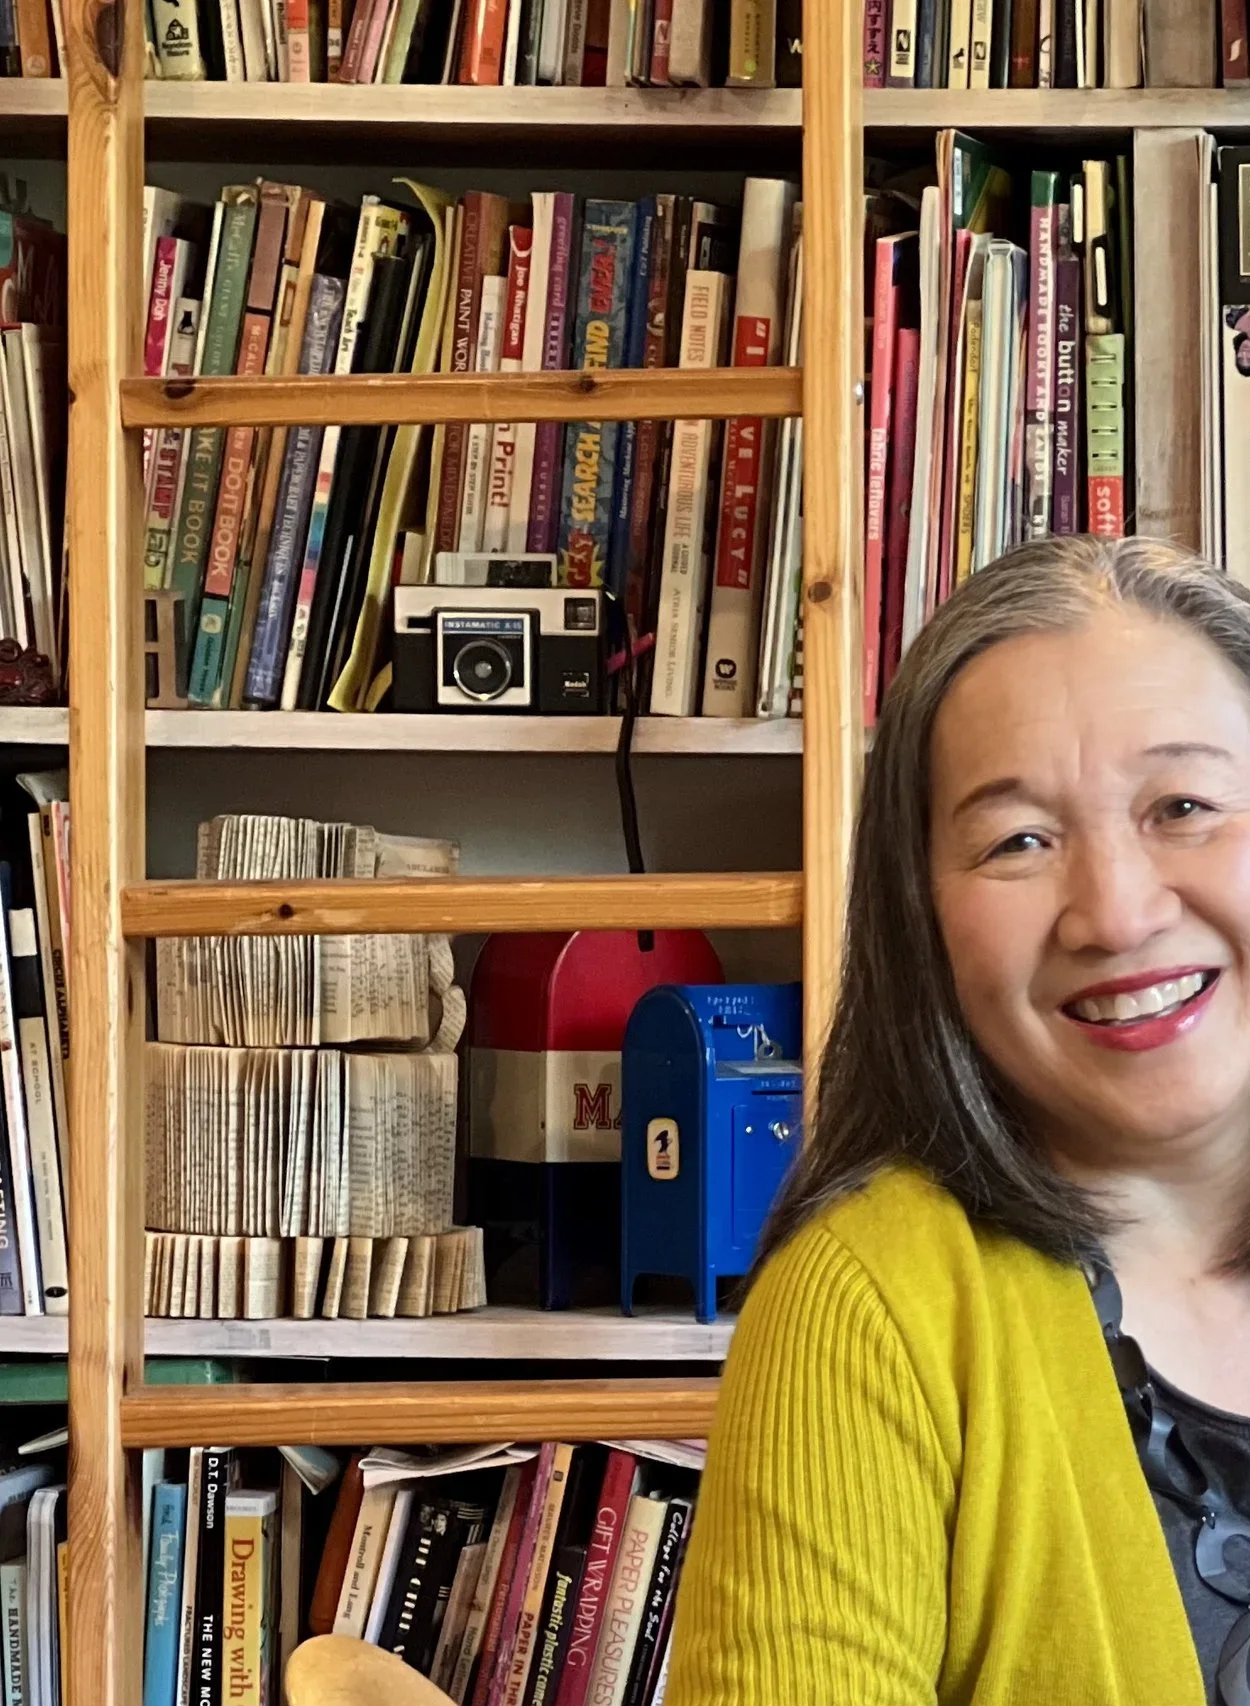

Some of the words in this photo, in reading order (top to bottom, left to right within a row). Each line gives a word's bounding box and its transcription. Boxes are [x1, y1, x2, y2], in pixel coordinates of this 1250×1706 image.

[550, 215, 569, 264] greeting
[158, 259, 173, 293] Jenny
[514, 263, 529, 286] Joe
[153, 296, 168, 321] Doh
[456, 287, 474, 332] PAINT
[509, 288, 527, 346] Rhatigan
[690, 284, 710, 320] FIELD
[1058, 303, 1076, 334] the
[686, 324, 708, 363] NOTES
[1055, 340, 1079, 414] button
[871, 427, 888, 471] fabric
[1054, 420, 1077, 477] maker
[489, 441, 516, 508] Print!
[570, 431, 603, 523] SEARCH
[675, 431, 701, 513] ADVENTUROUS
[672, 514, 692, 539] LIFE
[866, 471, 886, 541] leftovers
[180, 499, 207, 566] BOOK
[210, 516, 236, 577] BOOK
[443, 620, 501, 630] INSTAMATIC
[564, 680, 588, 690] Kodak
[207, 1456, 219, 1480] D.T.
[205, 1484, 218, 1530] Dawson
[355, 1523, 374, 1569] Montroll
[592, 1506, 618, 1556] GIFT
[662, 1511, 684, 1563] Collage
[350, 1570, 361, 1590] and
[618, 1528, 649, 1592] PAPER
[222, 1537, 255, 1641] Drawing
[548, 1570, 573, 1634] fantastic
[202, 1614, 214, 1642] THE
[514, 1611, 535, 1654] PAPER
[566, 1559, 609, 1668] WRAPPING
[644, 1605, 662, 1643] Soul
[8, 1606, 24, 1695] HANDMADE
[200, 1647, 213, 1682] NEW
[230, 1647, 254, 1700] with
[512, 1657, 524, 1675] IN
[538, 1630, 560, 1680] plastic
